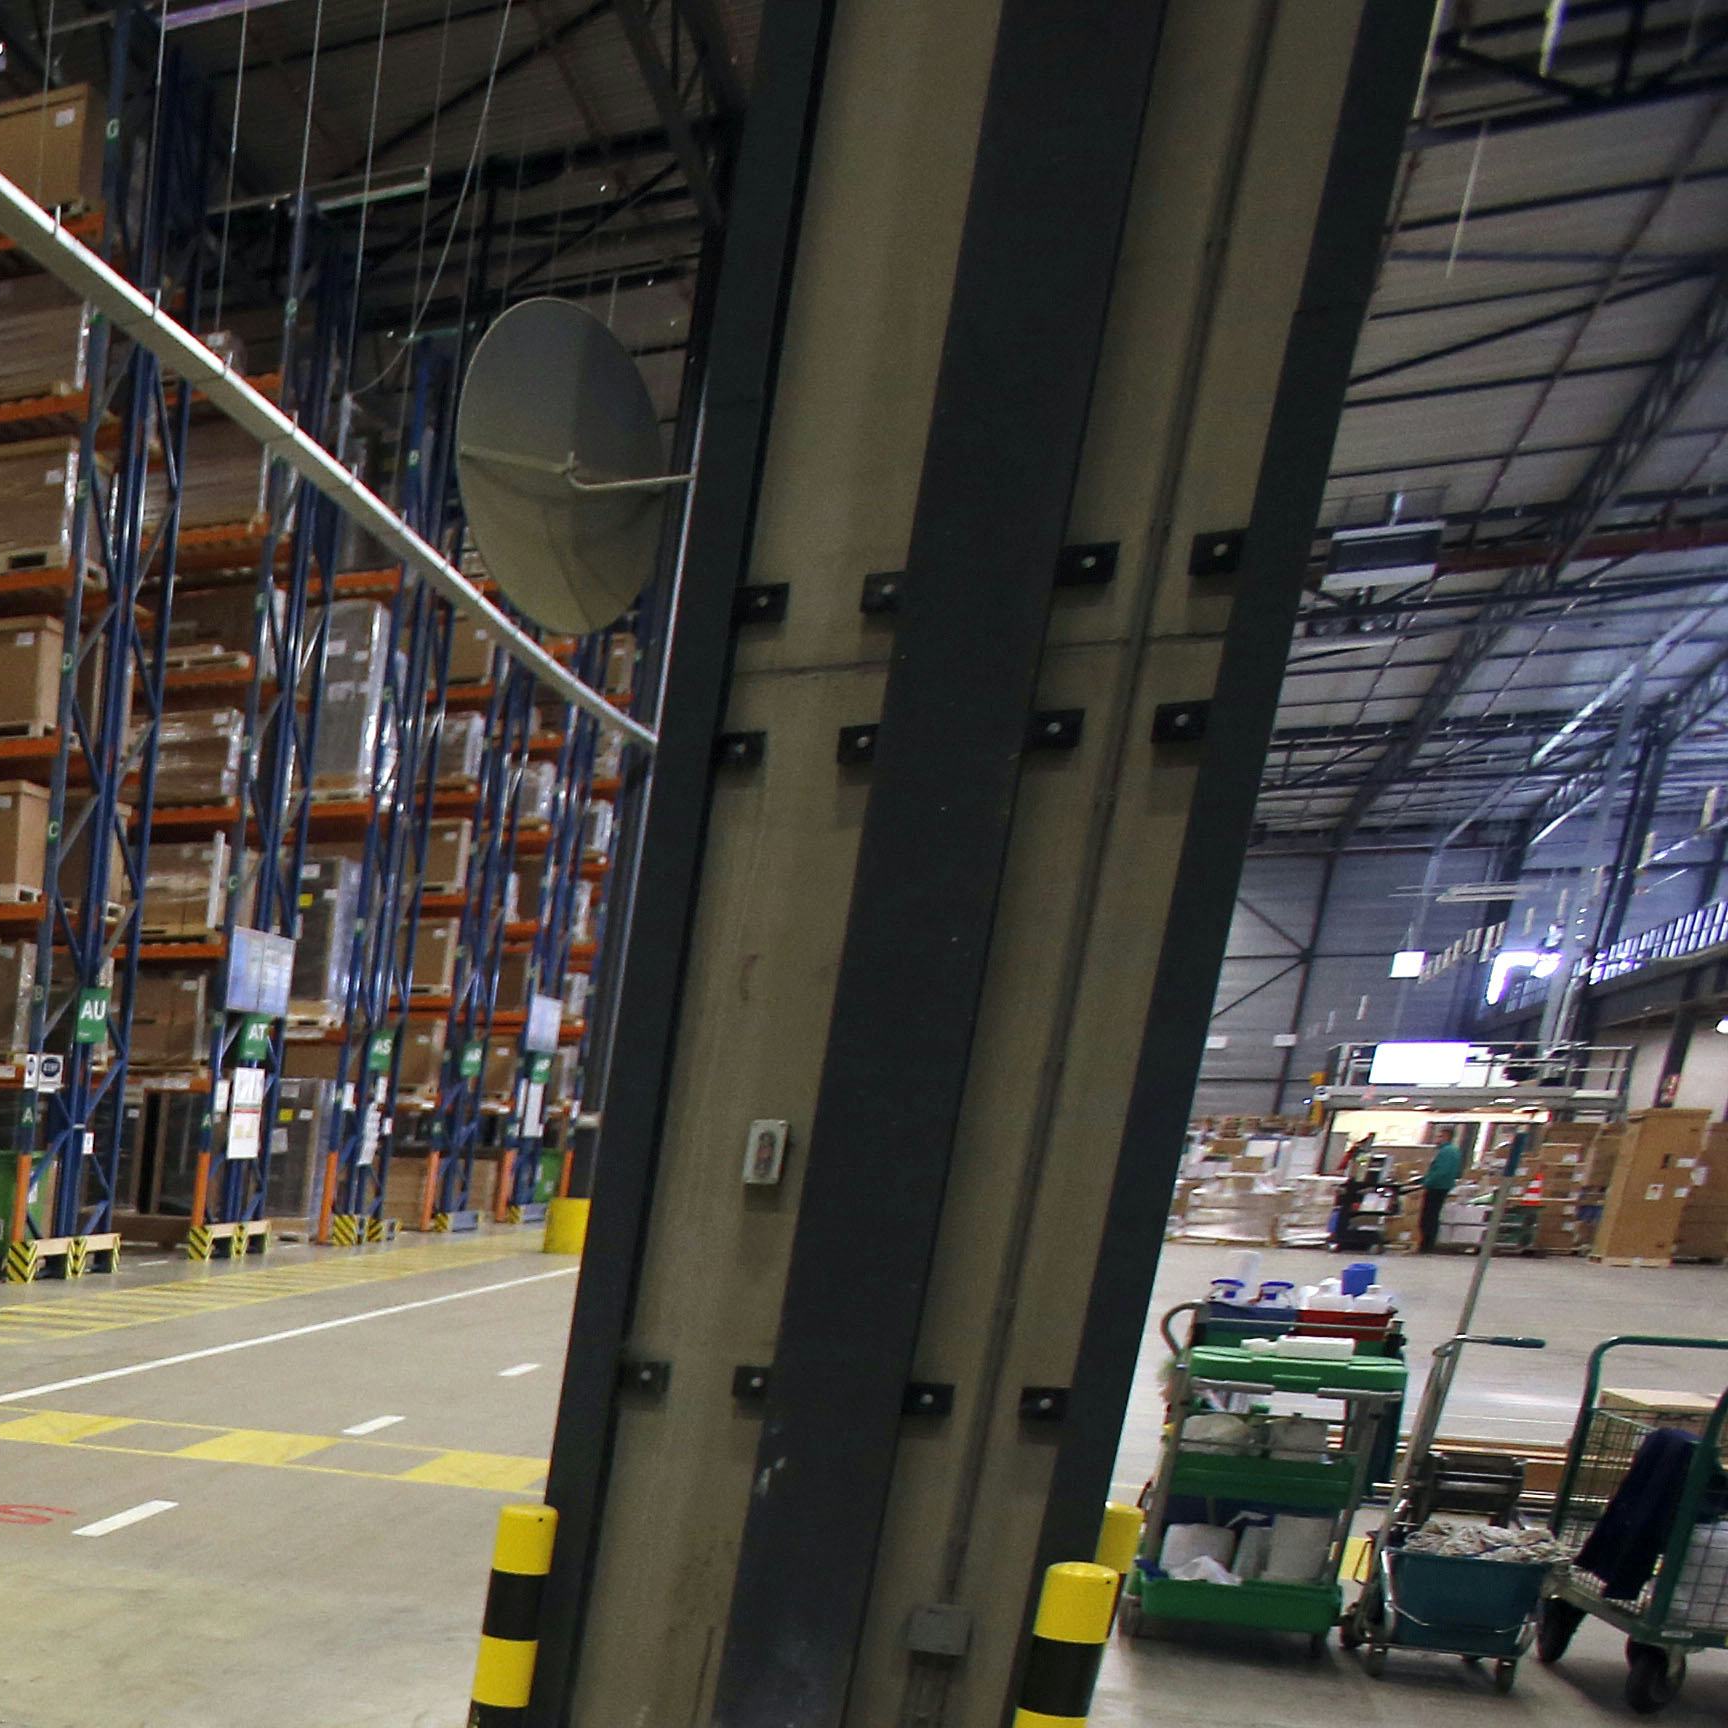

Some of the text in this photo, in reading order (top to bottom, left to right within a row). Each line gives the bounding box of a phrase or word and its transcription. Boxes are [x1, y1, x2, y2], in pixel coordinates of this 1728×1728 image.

[81, 999, 106, 1020] AU
[248, 1023, 269, 1041] AT
[374, 1039, 392, 1055] AS
[22, 1106, 33, 1122] A
